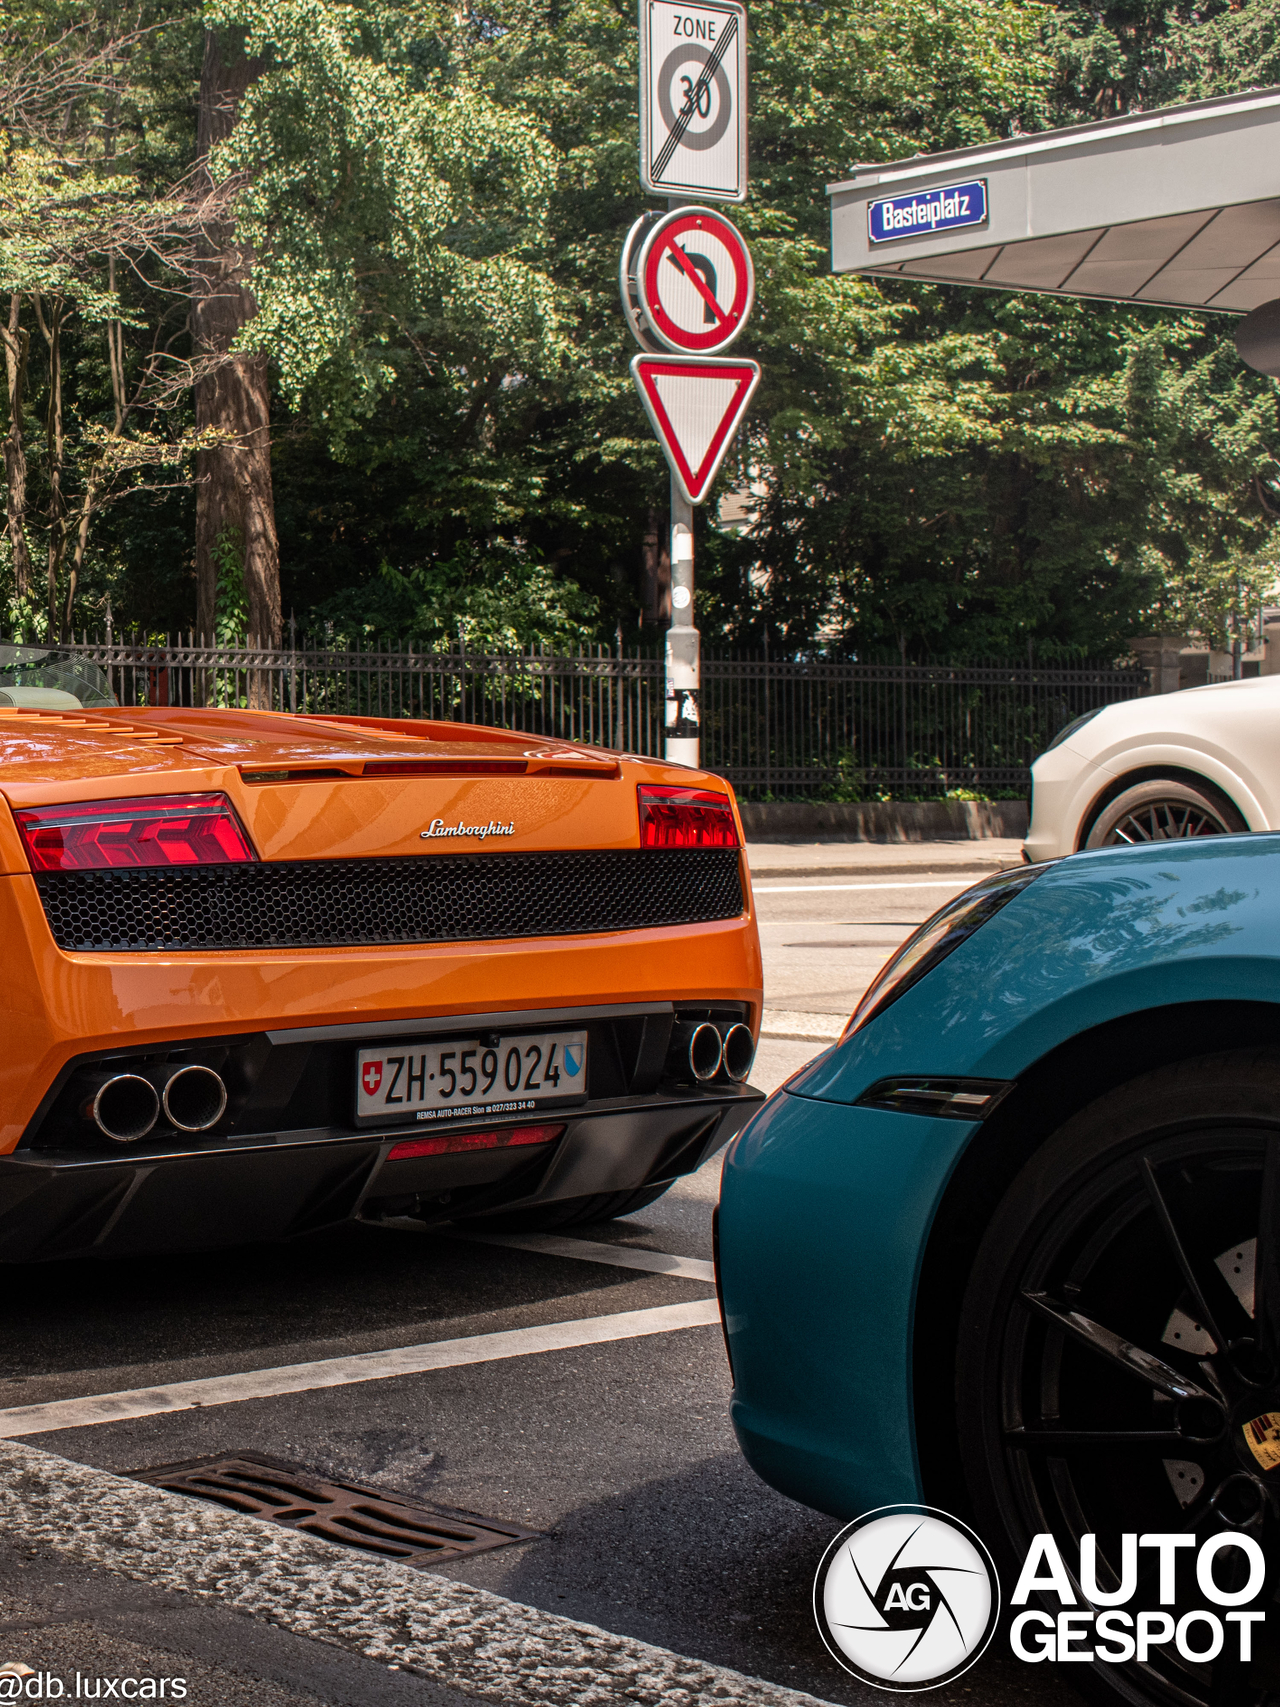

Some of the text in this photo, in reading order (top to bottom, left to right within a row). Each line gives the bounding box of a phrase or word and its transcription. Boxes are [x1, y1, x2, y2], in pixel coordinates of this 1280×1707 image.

[673, 15, 716, 41] ZONE
[680, 75, 711, 119] 30
[882, 191, 970, 231] Basteiplatz
[420, 818, 515, 840] Lamborghini
[505, 1042, 560, 1092] 024
[416, 1100, 535, 1120] REMSA AUTO-RACER Sion 027/323 34 40
